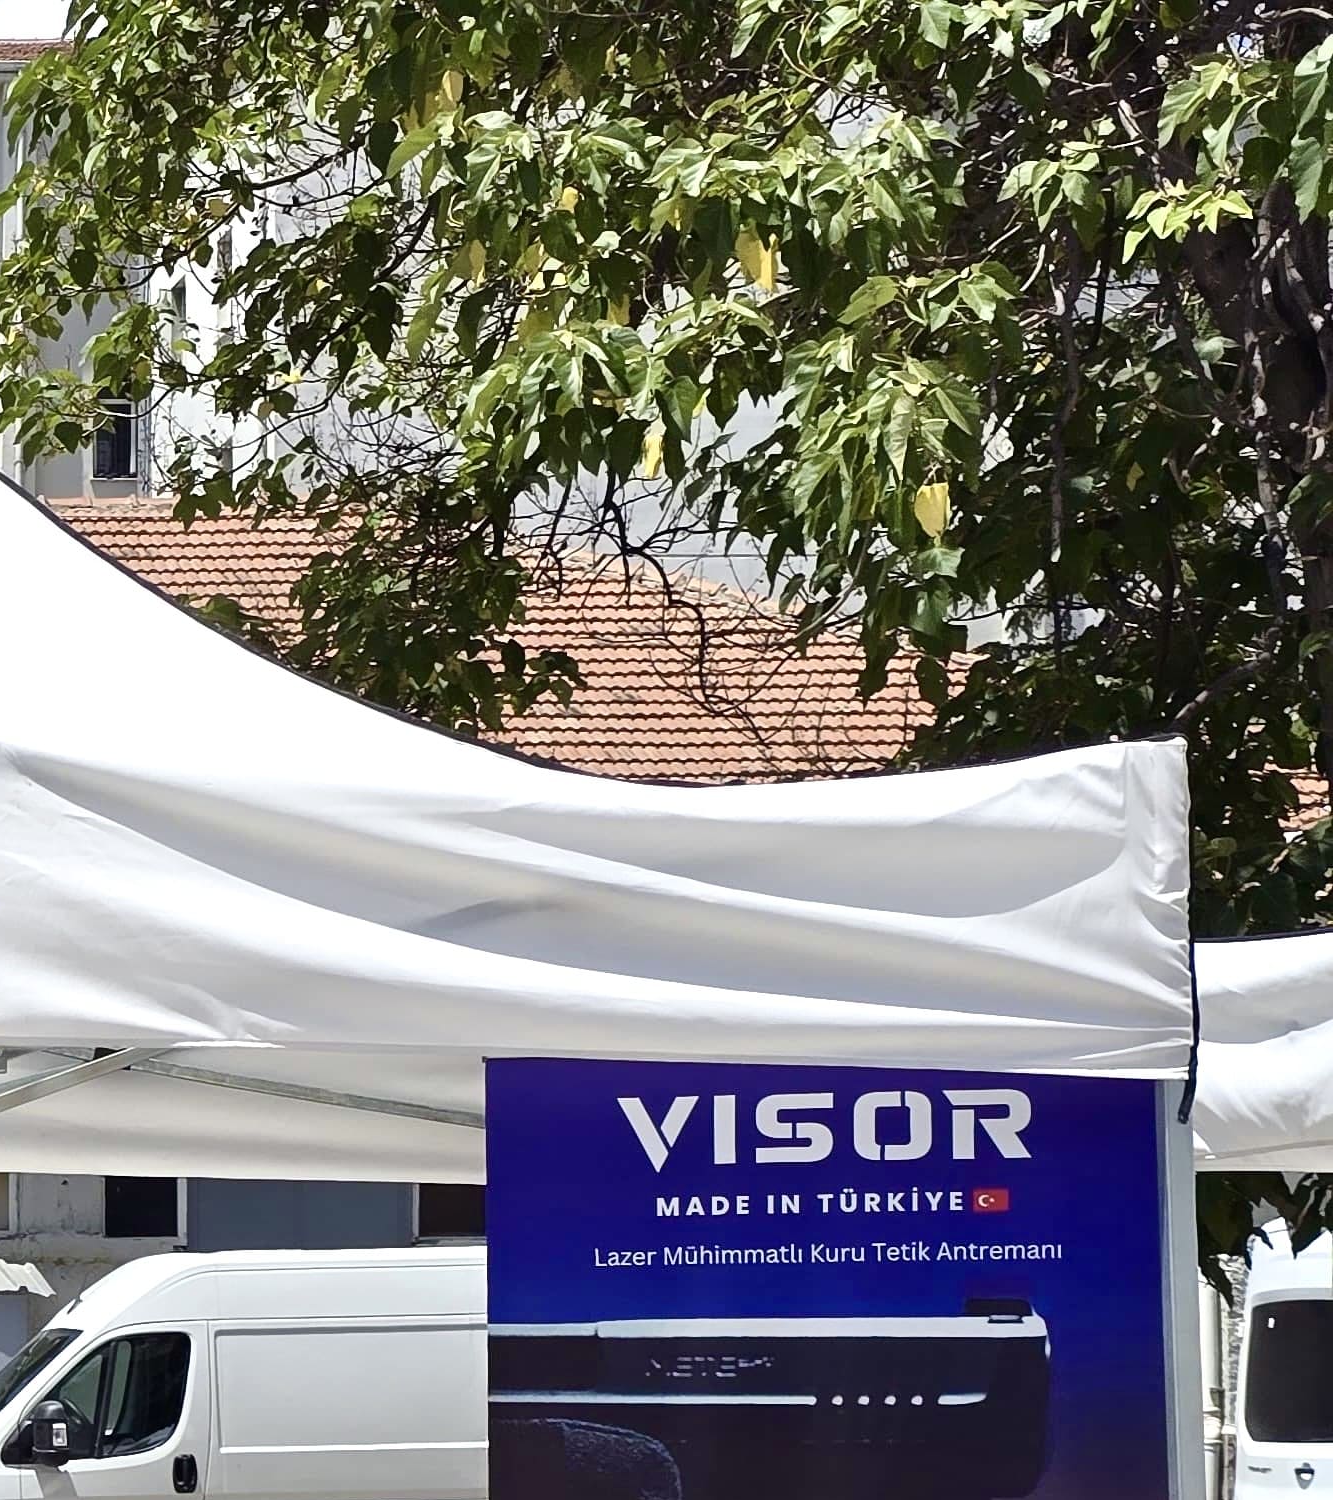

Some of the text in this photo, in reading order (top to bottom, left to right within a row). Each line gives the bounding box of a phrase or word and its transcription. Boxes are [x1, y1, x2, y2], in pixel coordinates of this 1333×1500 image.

[617, 1089, 1032, 1173] VISOR
[656, 1188, 965, 1216] MADE IN TÜRKİYE
[594, 1241, 1062, 1267] Lazer Mühimmatlı Kuru Tetik Antremanı
